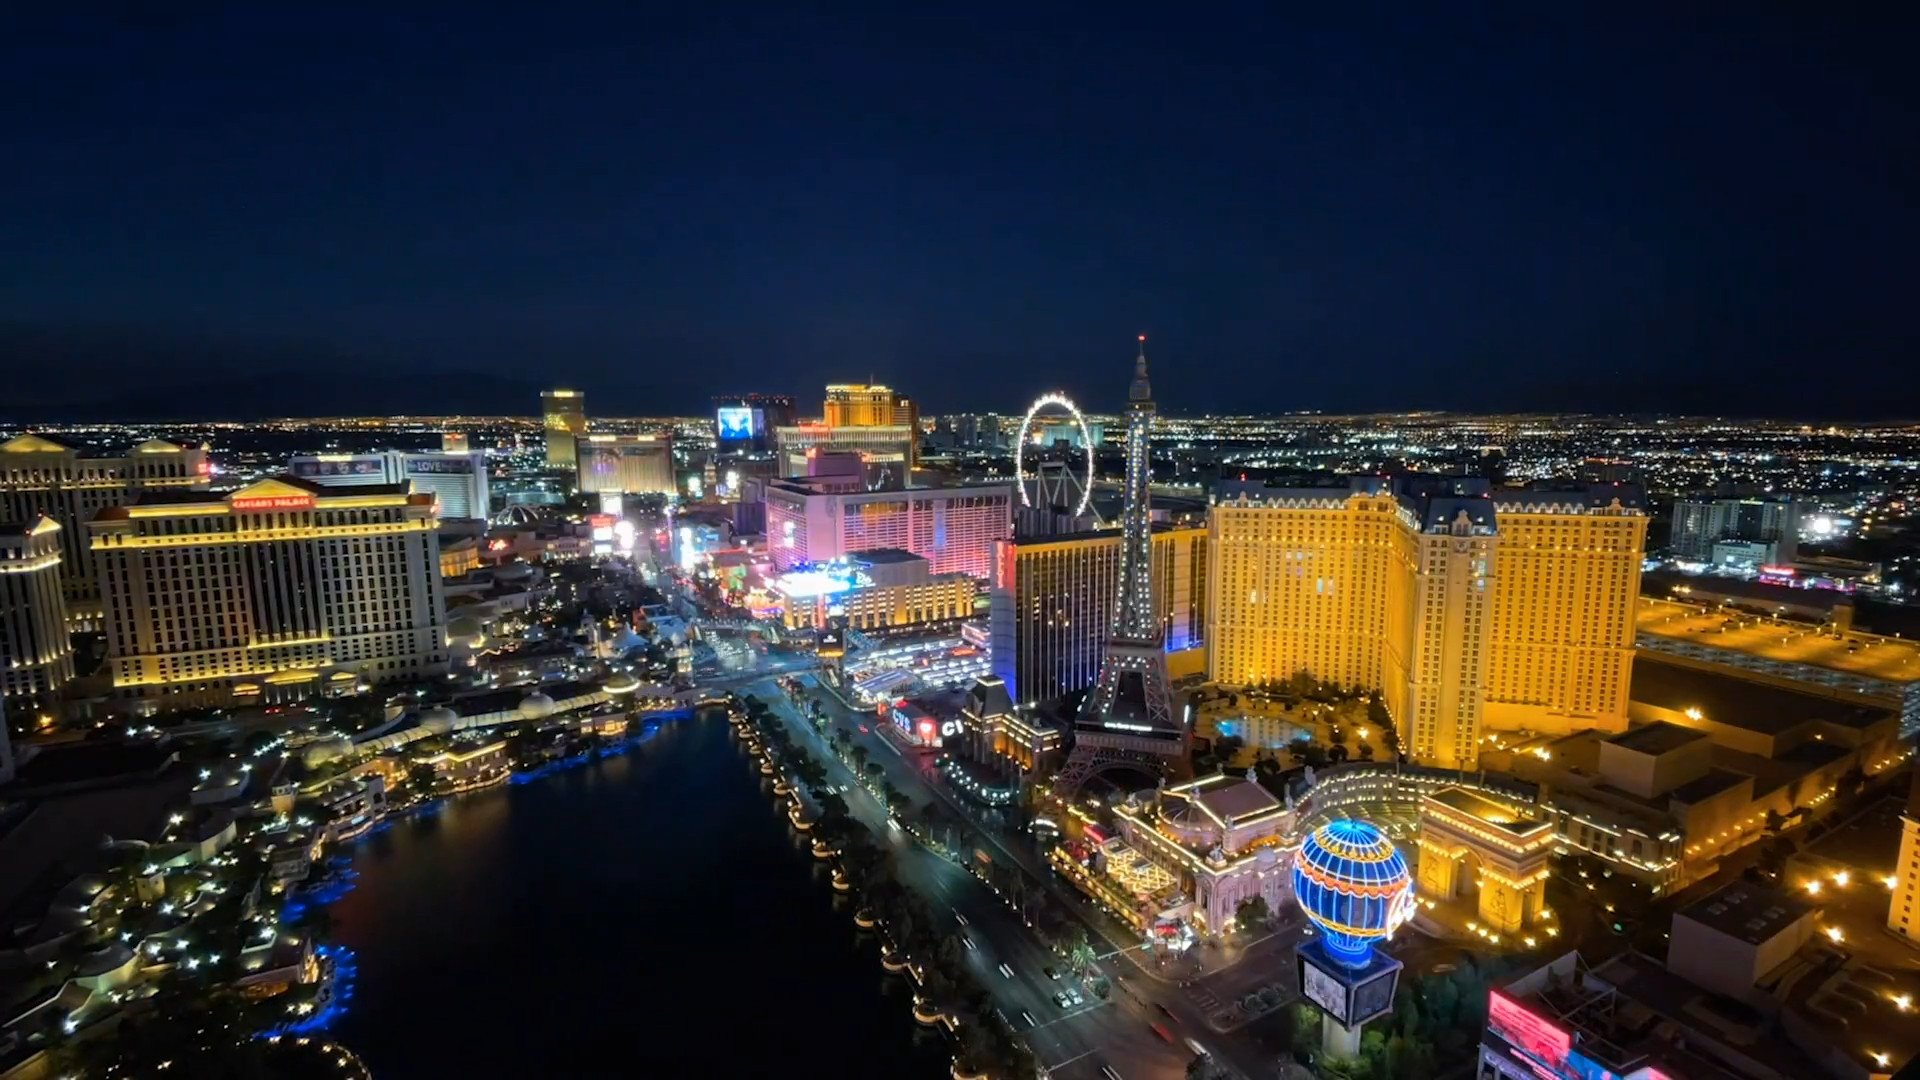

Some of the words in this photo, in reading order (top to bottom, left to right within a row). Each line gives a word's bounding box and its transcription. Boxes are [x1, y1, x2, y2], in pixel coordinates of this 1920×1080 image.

[417, 461, 441, 472] LOVE
[232, 499, 273, 508] CAESARS
[275, 498, 310, 506] PALACE
[893, 709, 911, 731] CVS
